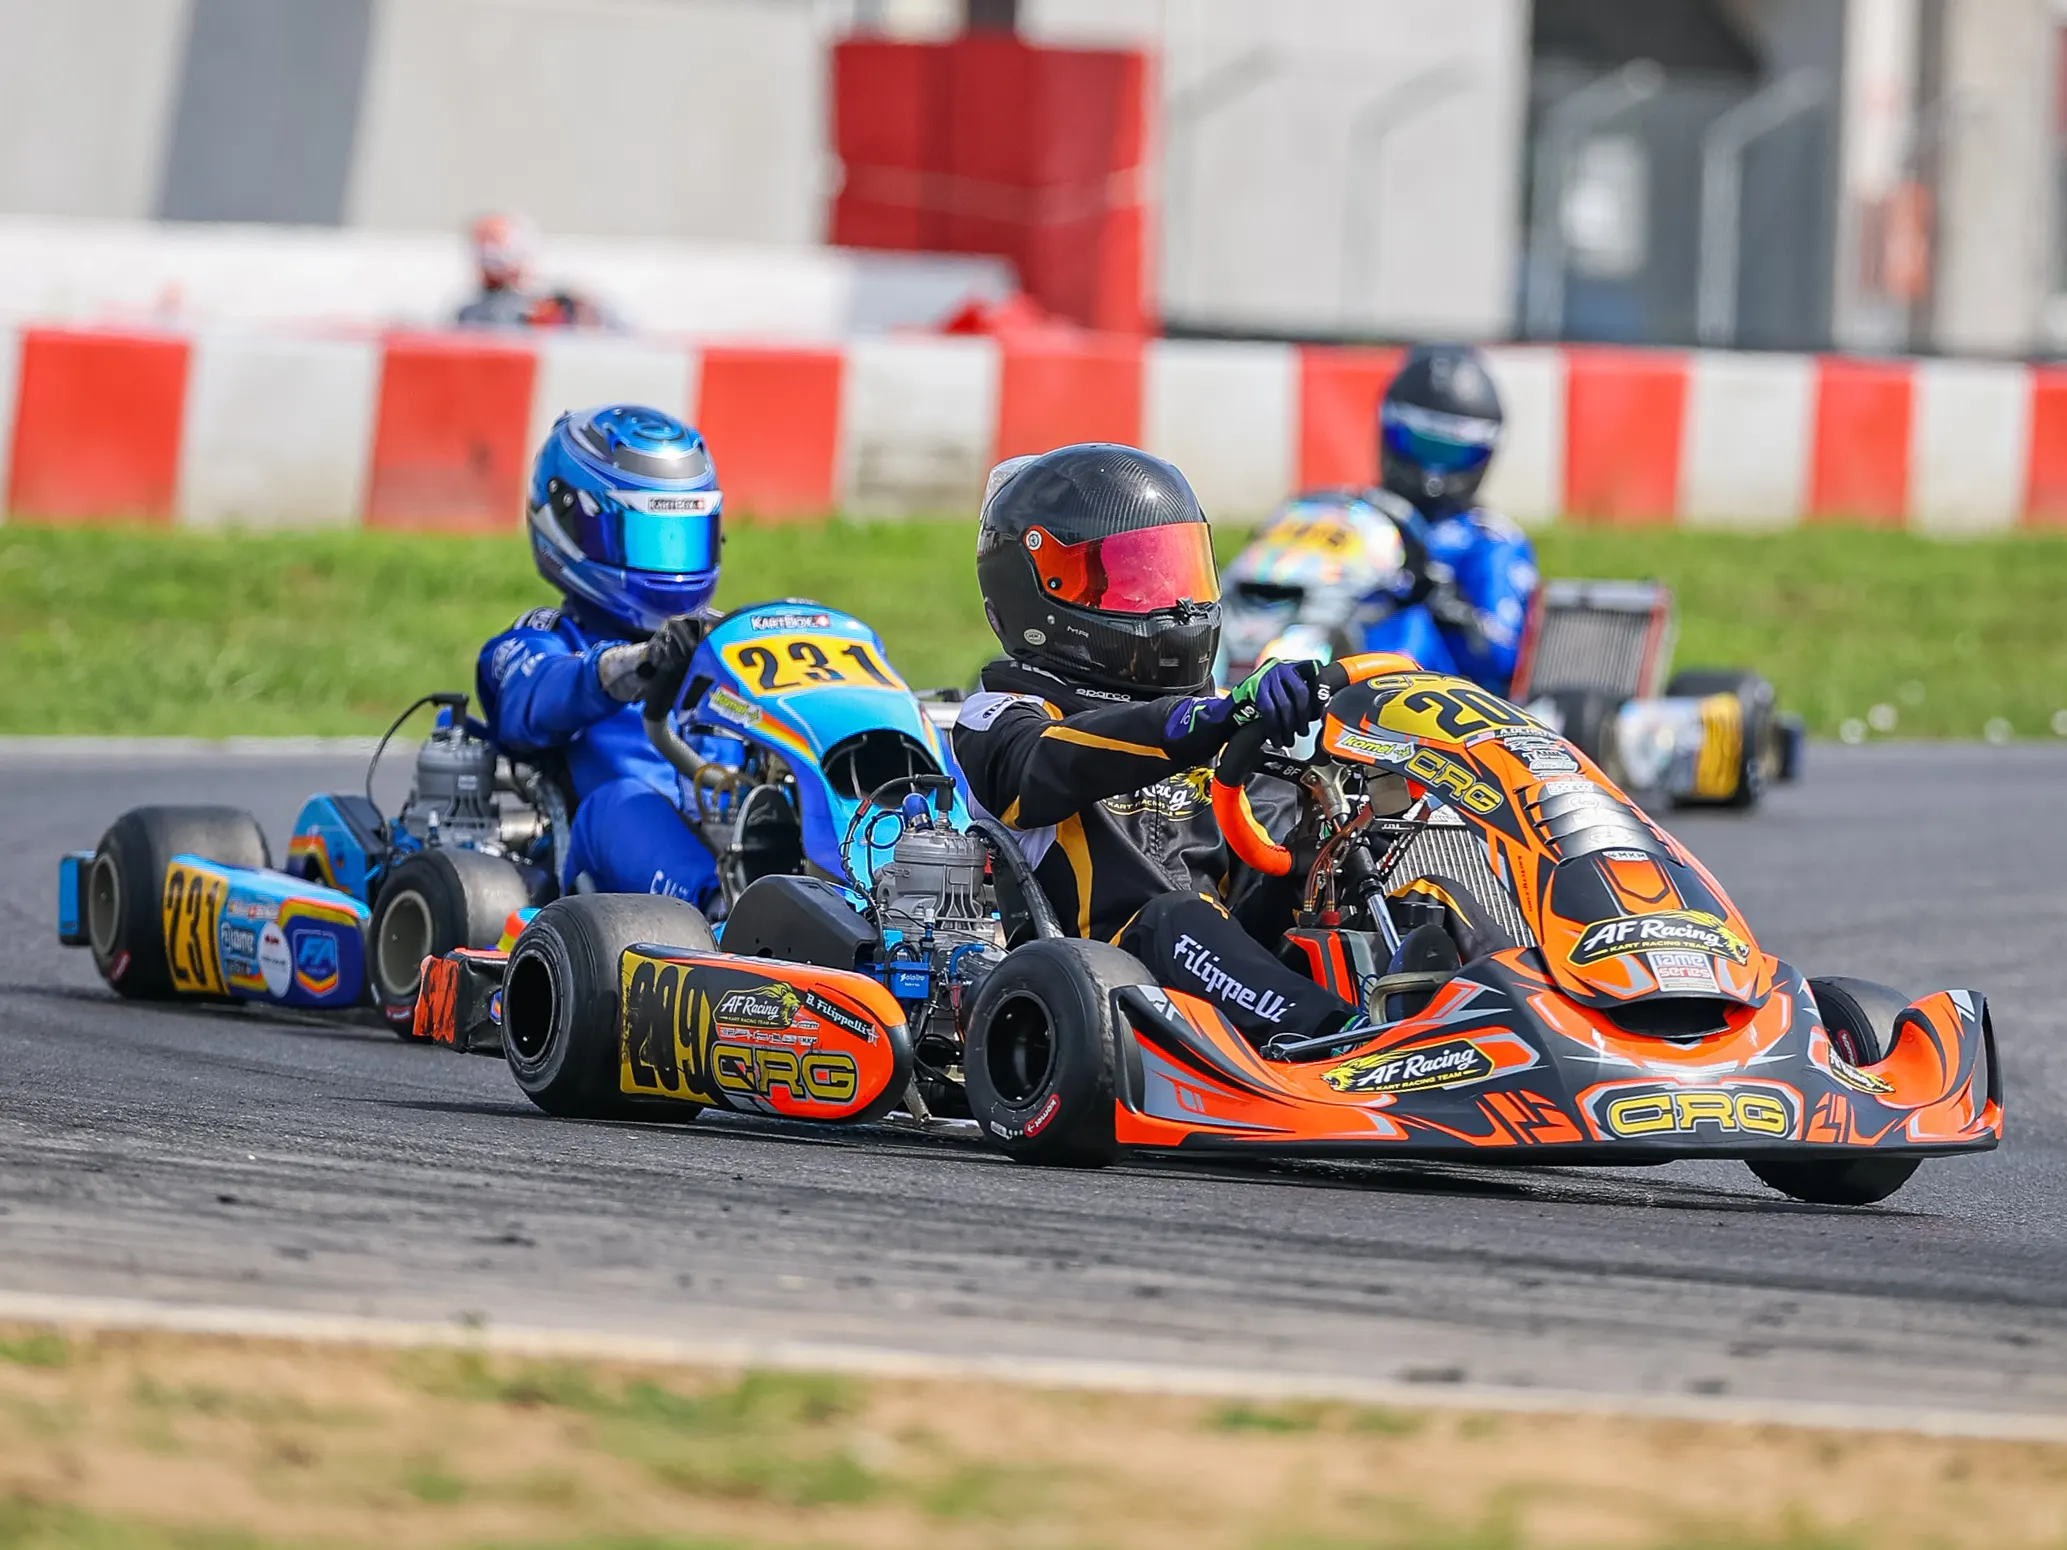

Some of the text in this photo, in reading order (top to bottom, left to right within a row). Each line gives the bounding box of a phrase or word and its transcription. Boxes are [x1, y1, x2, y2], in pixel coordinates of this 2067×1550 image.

[738, 642, 898, 690] 231
[1075, 687, 1131, 702] sparco
[1403, 688, 1538, 739] 20
[1404, 748, 1504, 814] CRG
[167, 870, 227, 995] 231
[1584, 919, 1727, 952] AF Racing
[1609, 942, 1639, 953] KART
[1682, 941, 1710, 951] TEAM
[1173, 933, 1297, 1024] Filippelli
[720, 995, 780, 1020] AF Racing
[816, 1002, 868, 1035] Filippelli
[711, 1041, 859, 1105] CRG
[1356, 1048, 1480, 1087] AF Racing
[1376, 1072, 1463, 1091] KART RACING TEAM
[1608, 1091, 1790, 1139] CRG
